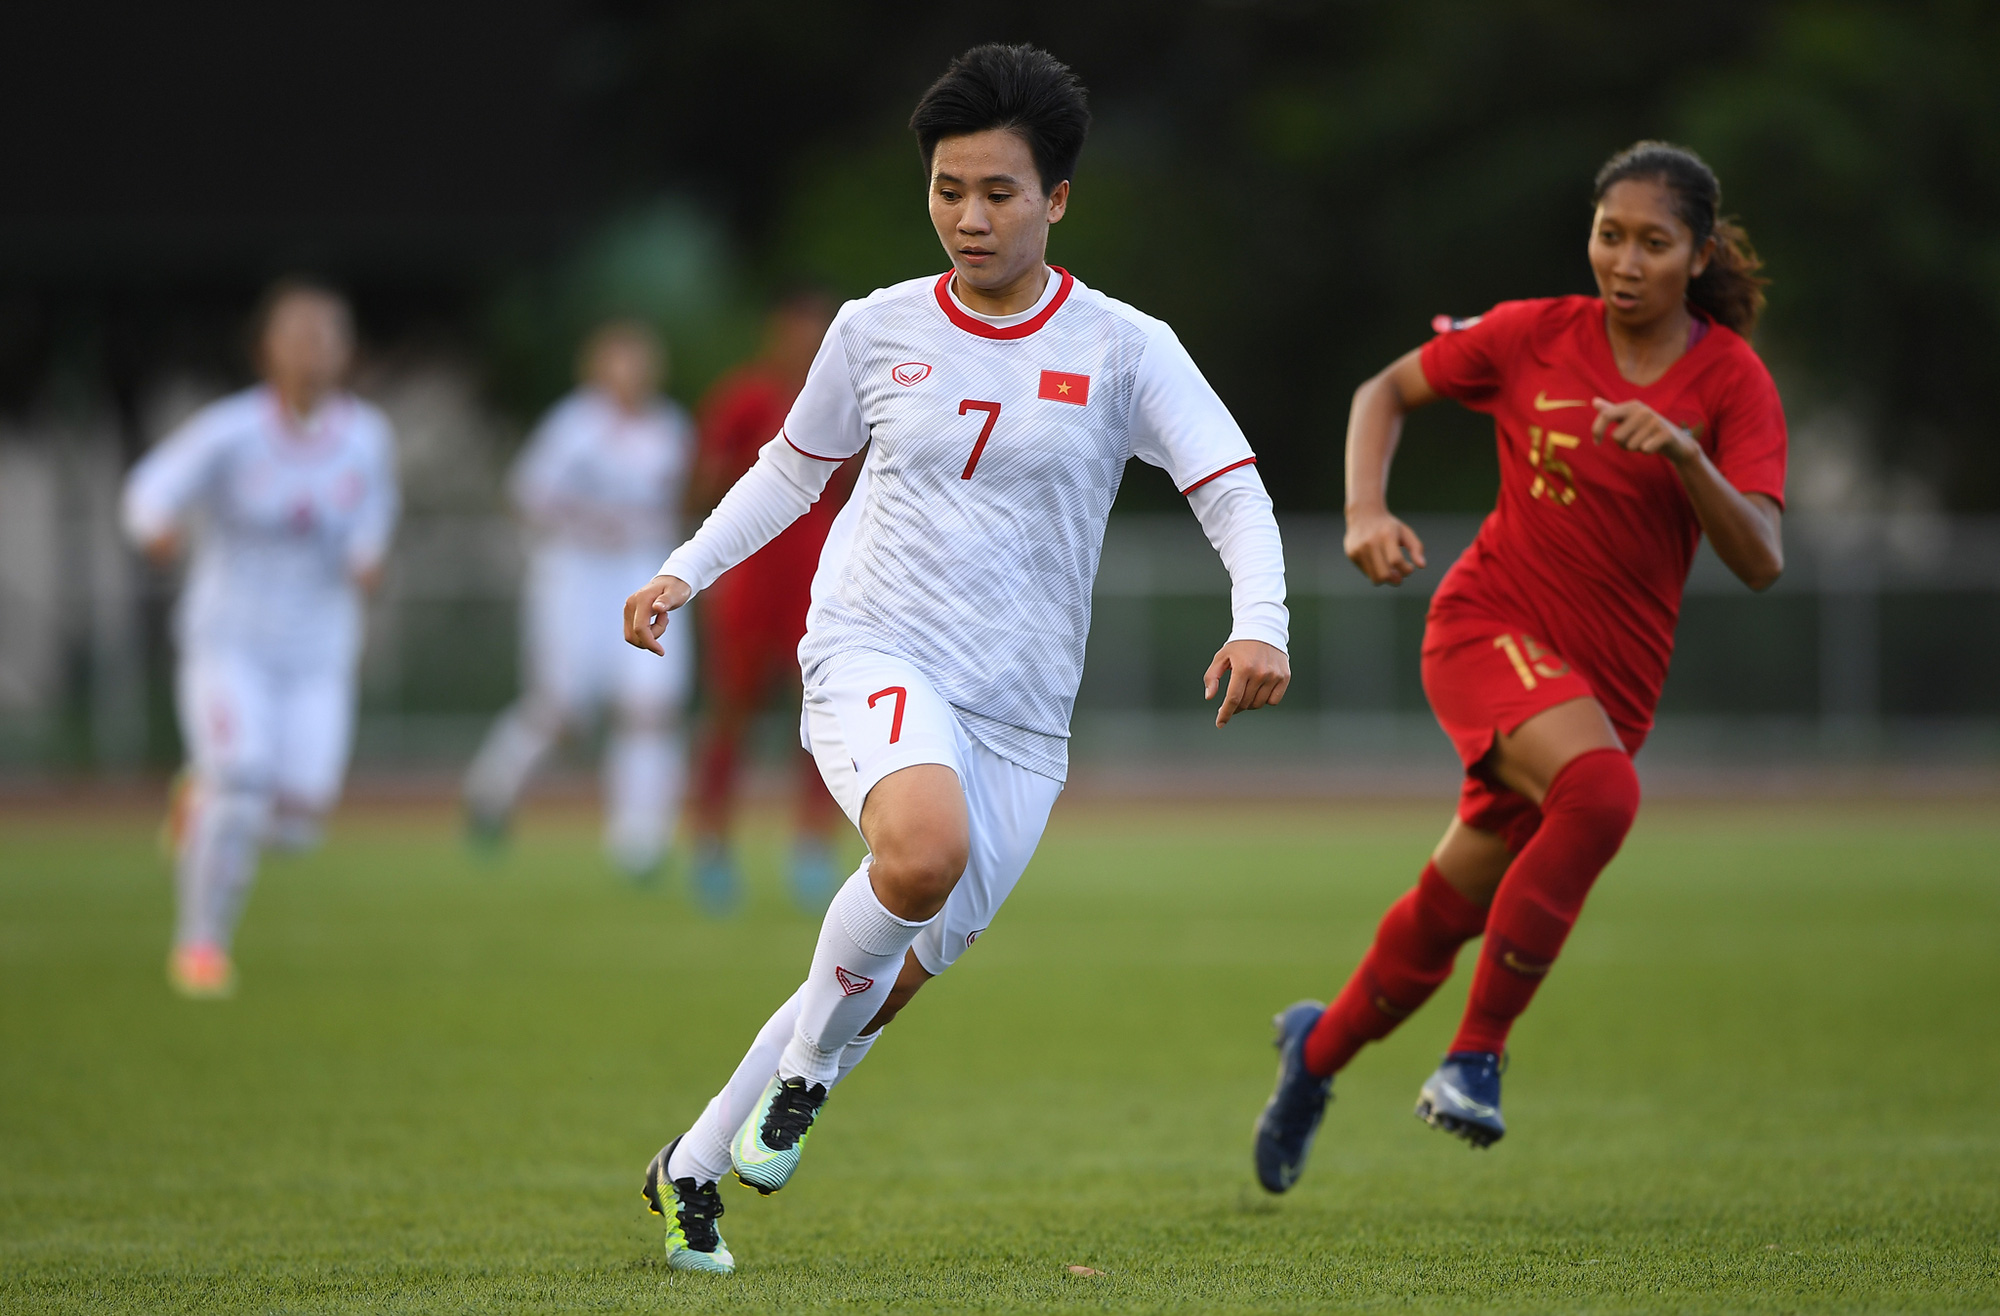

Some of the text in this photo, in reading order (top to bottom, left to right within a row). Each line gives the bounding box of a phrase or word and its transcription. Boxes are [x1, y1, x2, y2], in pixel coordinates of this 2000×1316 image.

[958, 399, 1001, 480] 7
[1529, 426, 1580, 505] 15
[1493, 633, 1570, 691] 15
[868, 686, 906, 744] 7
